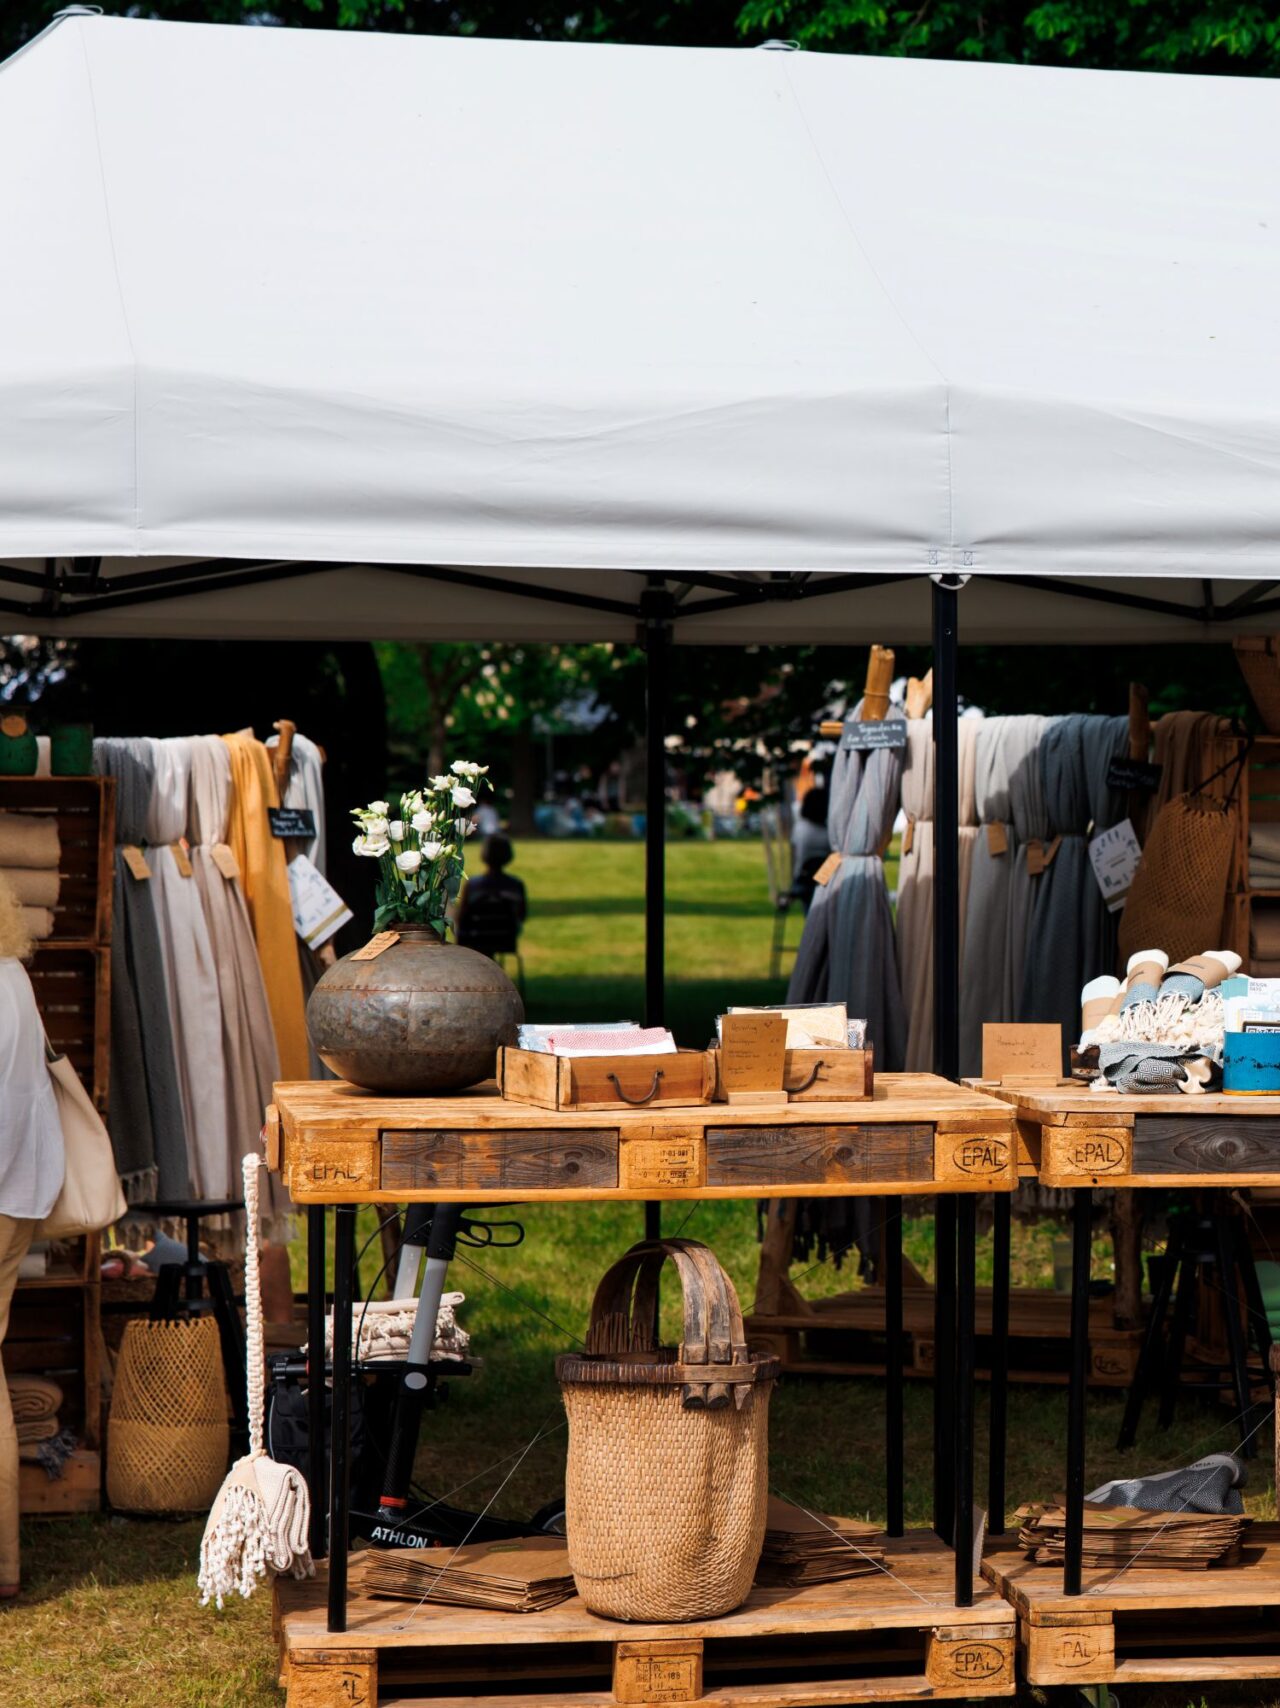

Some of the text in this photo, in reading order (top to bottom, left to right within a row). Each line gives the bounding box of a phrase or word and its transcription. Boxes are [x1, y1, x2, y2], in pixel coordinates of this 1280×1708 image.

[962, 1146, 1003, 1167] EPAL
[1075, 1142, 1115, 1163] EPAL
[371, 1526, 428, 1548] ATHLON
[955, 1652, 996, 1672] EPAL
